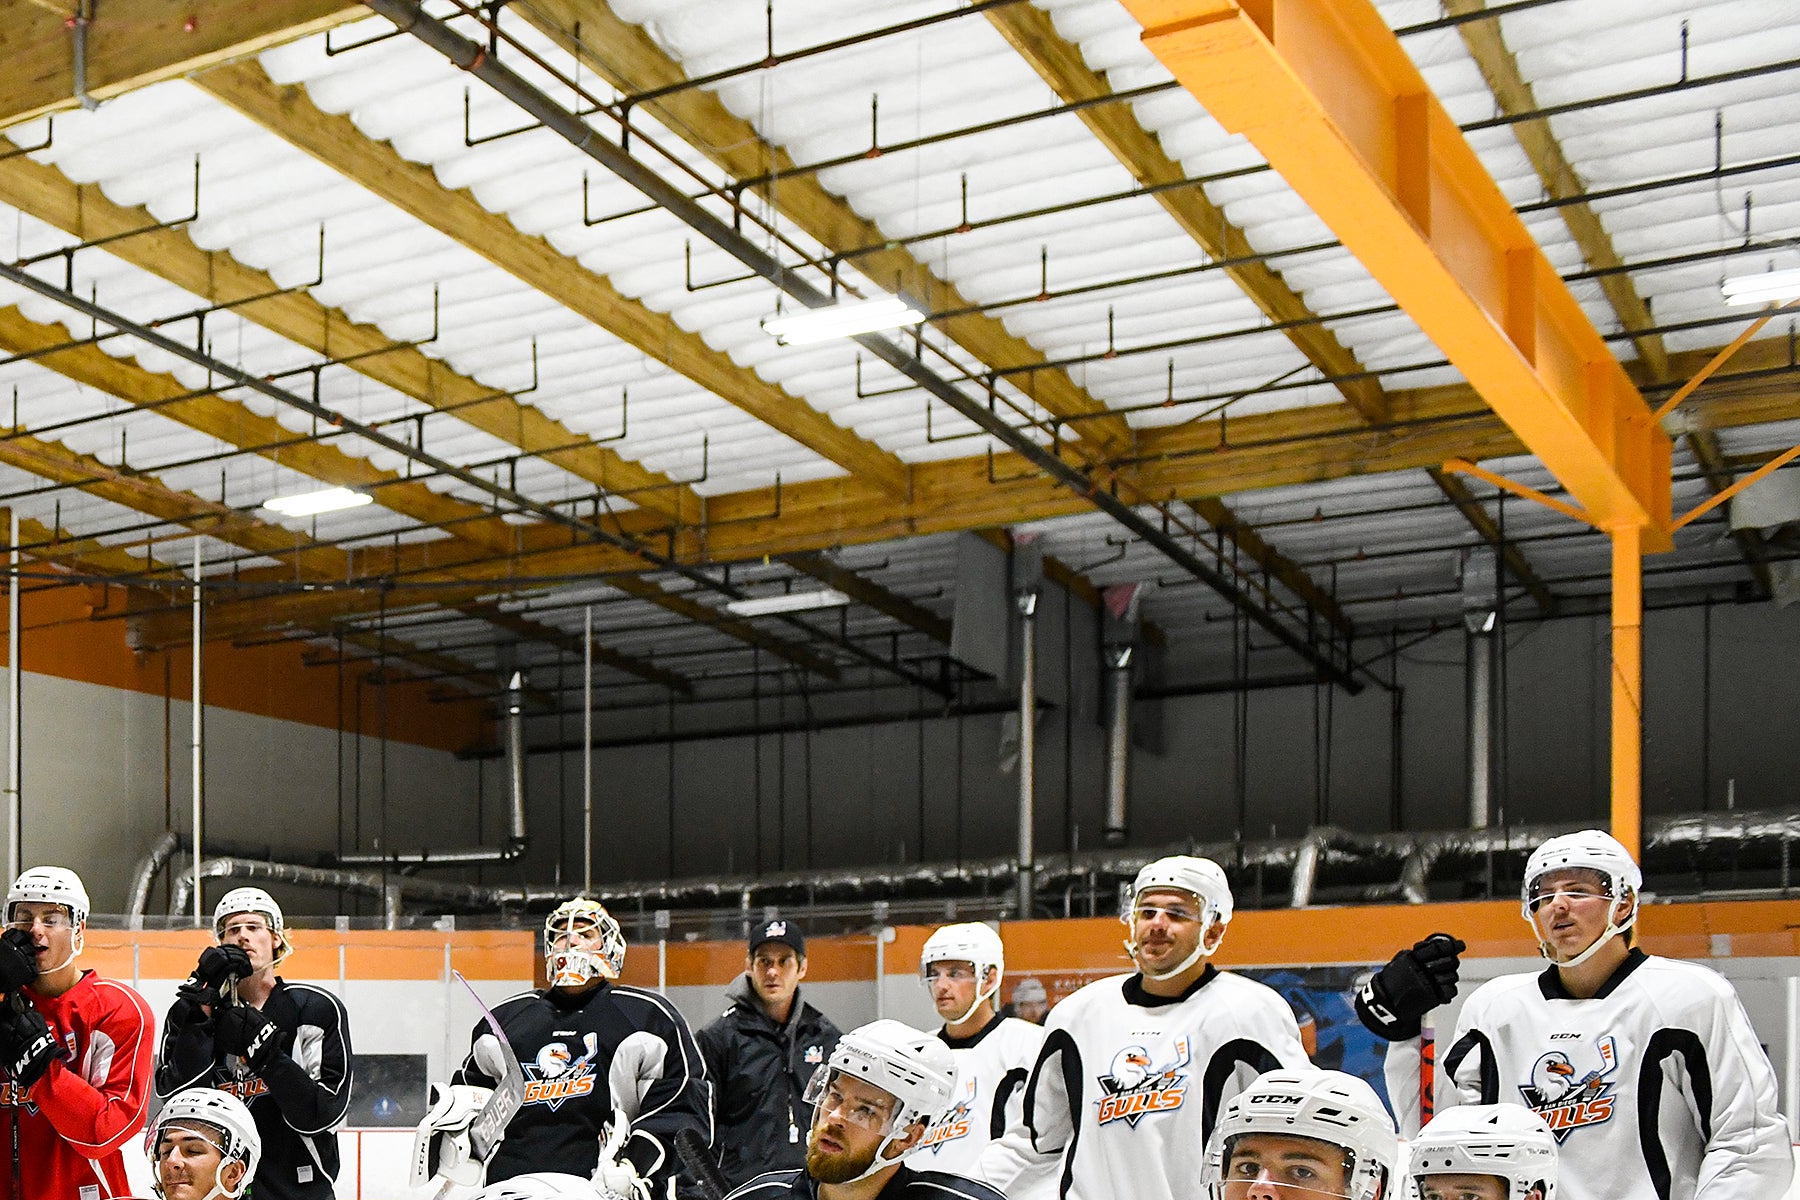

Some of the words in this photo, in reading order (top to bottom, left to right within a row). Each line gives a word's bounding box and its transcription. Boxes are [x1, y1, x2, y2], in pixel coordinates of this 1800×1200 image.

[523, 1074, 598, 1103] GULLS
[1249, 1094, 1304, 1105] CCM
[1098, 1087, 1186, 1125] GULLS
